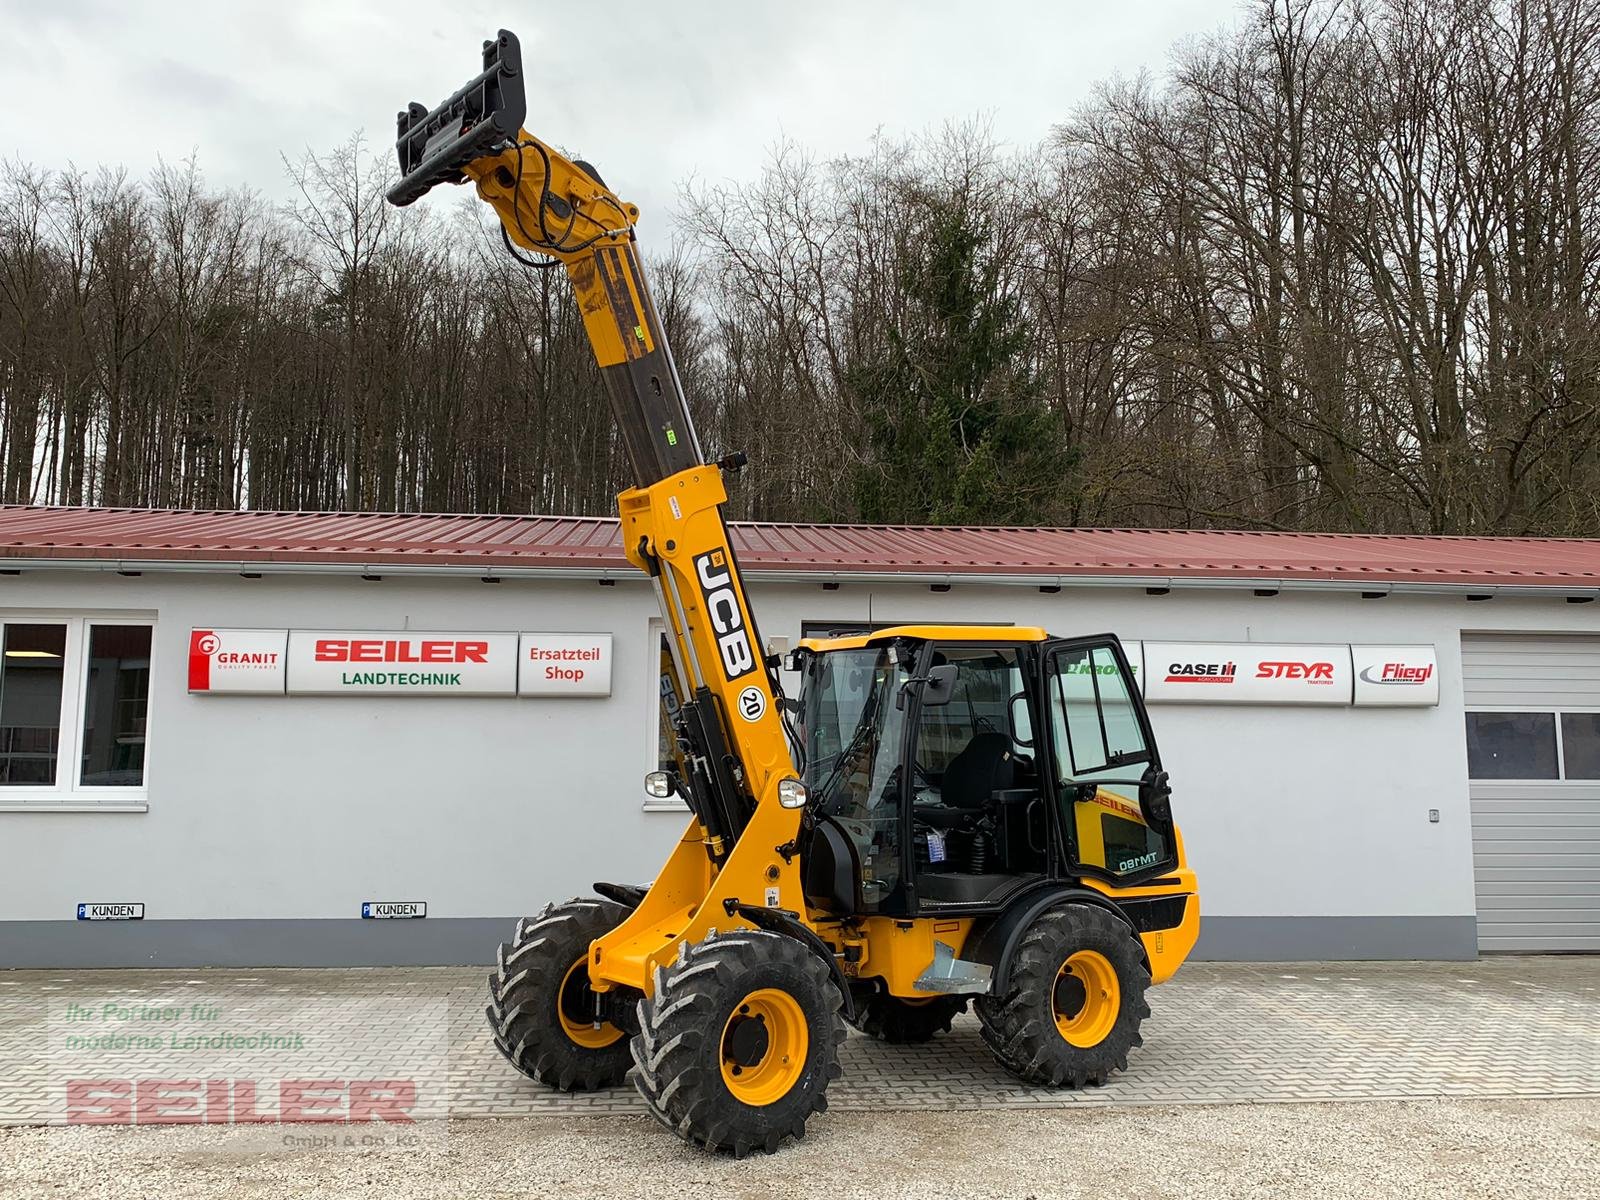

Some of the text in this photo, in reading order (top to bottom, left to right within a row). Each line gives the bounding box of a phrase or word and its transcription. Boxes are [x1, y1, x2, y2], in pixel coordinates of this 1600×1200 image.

[697, 555, 753, 679] JCB
[217, 652, 278, 664] GRANIT
[315, 640, 489, 663] SEILER
[530, 647, 600, 661] Ersatzteil
[545, 666, 584, 682] Shop
[1169, 663, 1219, 676] CASE
[1255, 662, 1334, 679] STEYR
[1382, 663, 1433, 682] Fliegl
[342, 672, 462, 686] LANDTECHNIK
[742, 692, 761, 717] 20
[78, 905, 135, 916] P KUNDEN
[363, 904, 417, 914] P KUNDEN
